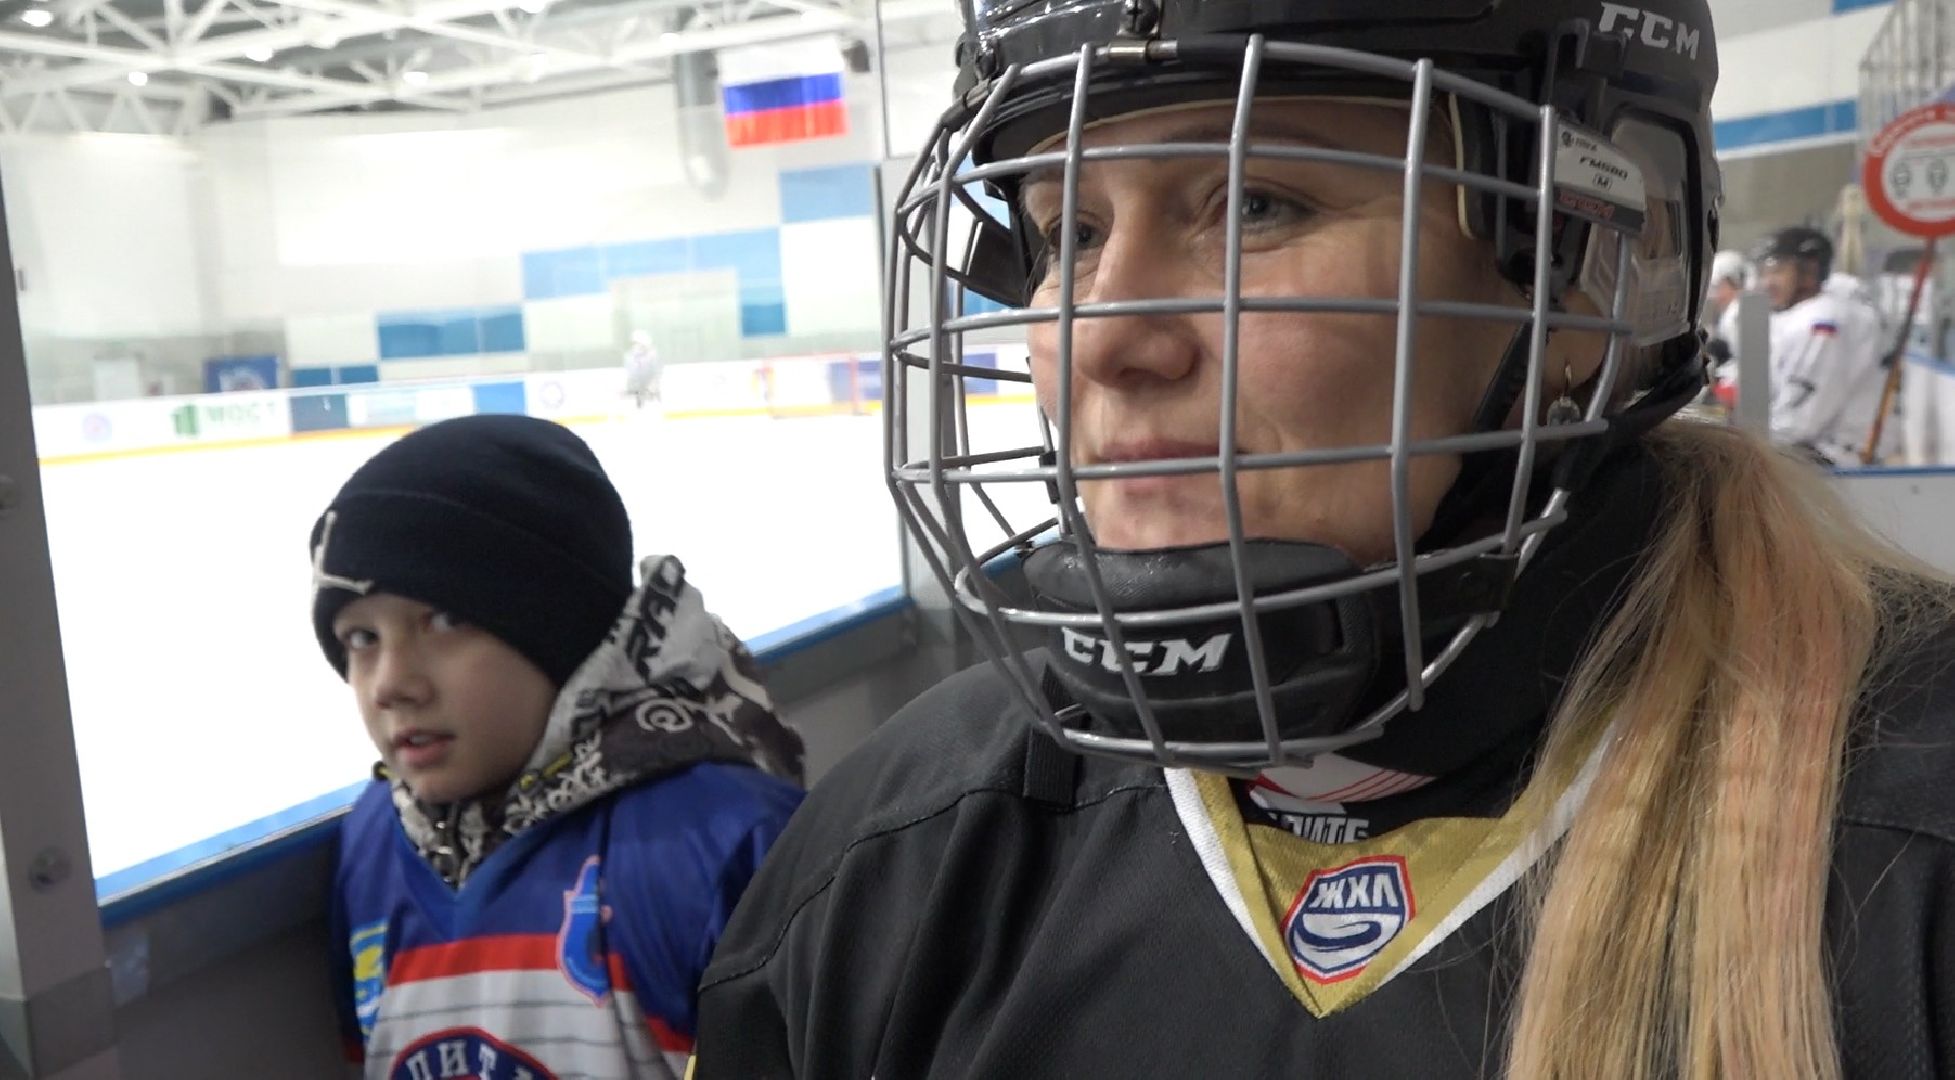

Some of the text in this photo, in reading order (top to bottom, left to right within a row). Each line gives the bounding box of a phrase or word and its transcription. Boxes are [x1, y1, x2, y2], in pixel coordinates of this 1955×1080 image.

[1599, 2, 1700, 60] CCM
[1061, 626, 1232, 675] CCM
[1308, 873, 1399, 909] ЖХЛ
